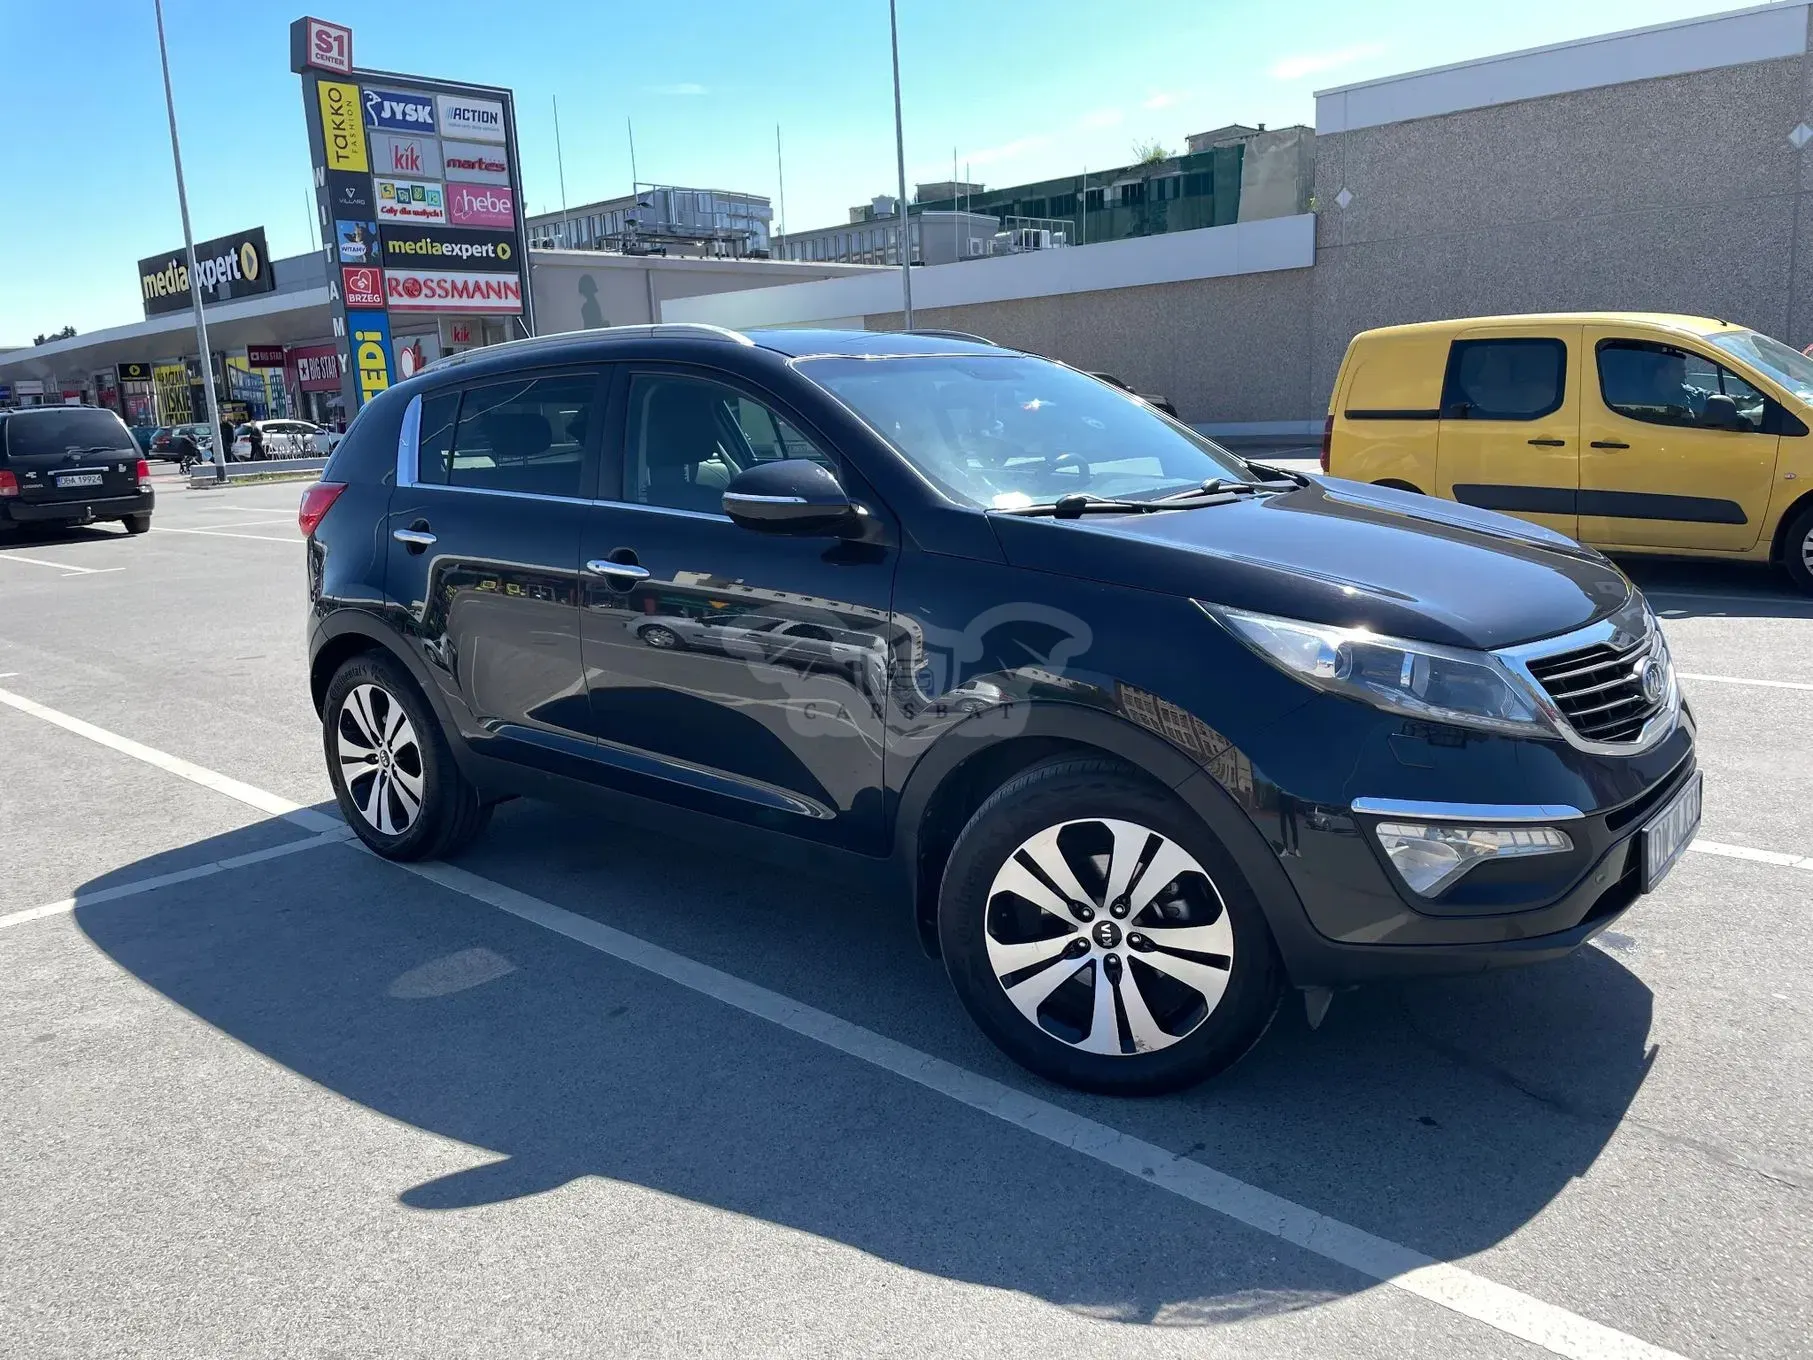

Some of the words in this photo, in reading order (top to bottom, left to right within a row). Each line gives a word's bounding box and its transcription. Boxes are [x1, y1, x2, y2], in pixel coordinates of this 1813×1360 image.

[315, 29, 345, 58] S1
[315, 52, 345, 67] CENTER
[381, 101, 433, 124] JYSK
[453, 107, 498, 125] ACTION
[346, 100, 358, 154] FASHION
[394, 143, 420, 171] kik
[446, 157, 506, 173] martes
[463, 189, 511, 213] hebe
[388, 238, 496, 260] mediaexpert
[142, 247, 242, 299] mediaxpert
[349, 294, 381, 303] BRZEG
[387, 276, 521, 300] ROSSMANN
[453, 326, 471, 342] kik
[309, 358, 320, 380] BIG
[320, 355, 338, 379] STAR
